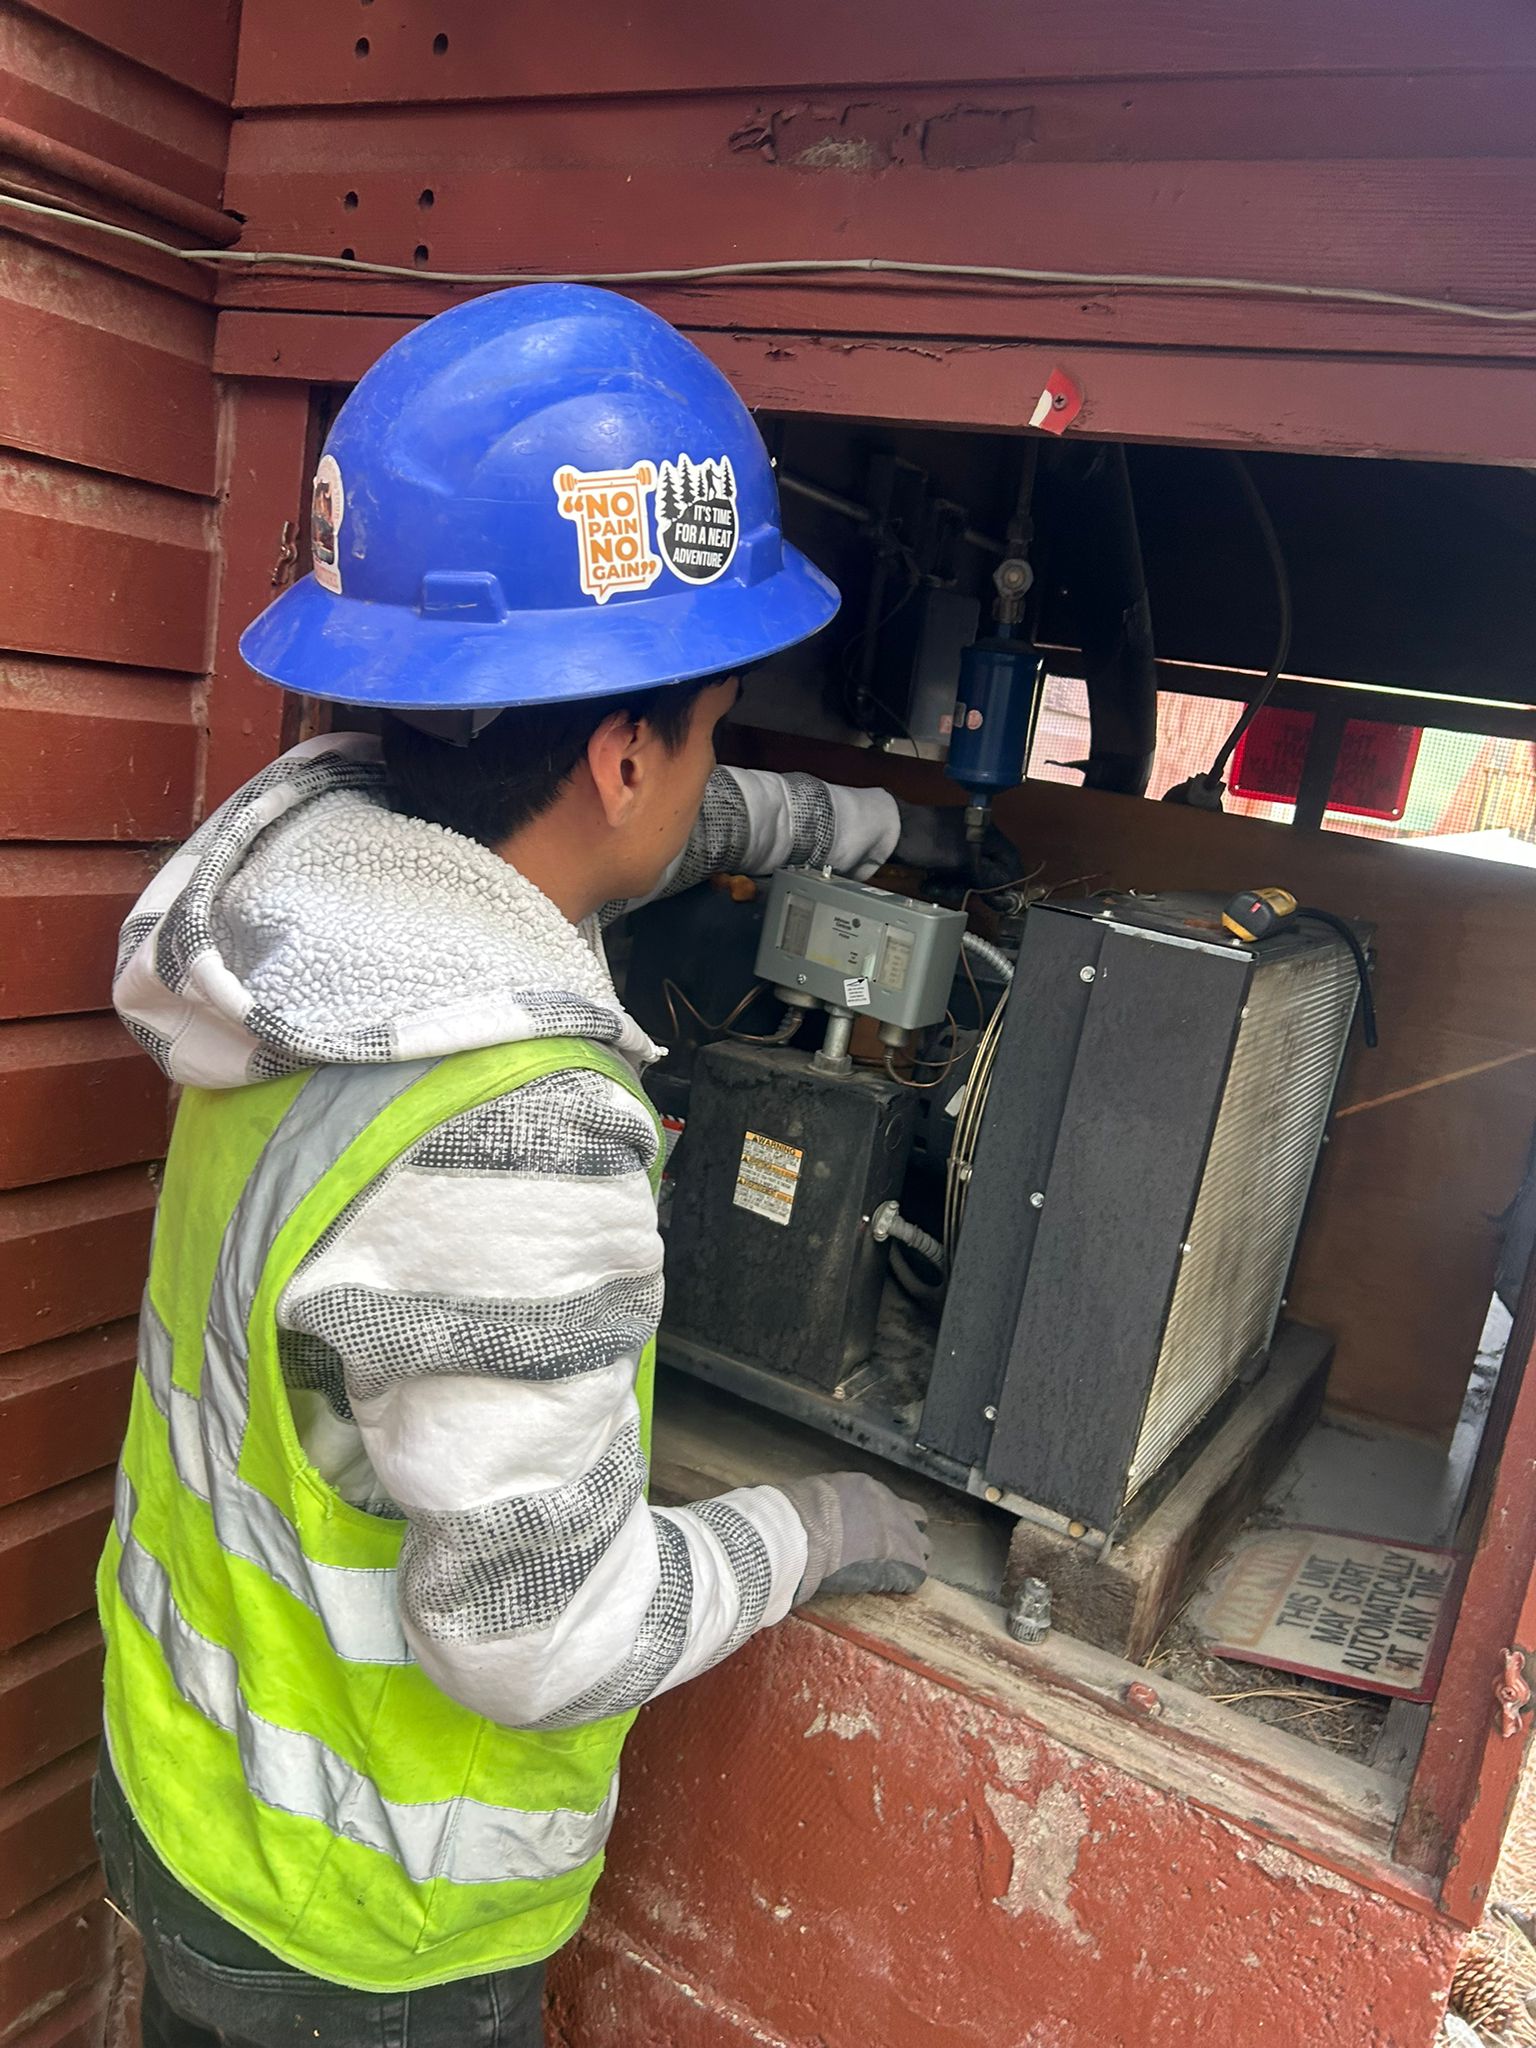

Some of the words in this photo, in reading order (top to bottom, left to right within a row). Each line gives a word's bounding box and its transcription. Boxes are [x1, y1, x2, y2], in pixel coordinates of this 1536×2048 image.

[588, 518, 638, 538] PAIN
[694, 504, 712, 522] IT'S
[713, 507, 732, 526] TIME
[590, 536, 639, 564] NO
[674, 524, 697, 543] FOR
[699, 527, 706, 544] A
[709, 527, 733, 548] NEAT
[672, 547, 724, 568] ADVENTURE
[759, 1135, 796, 1156] WARNING
[1276, 1592, 1321, 1629] THIS
[1299, 1554, 1342, 1589] UNIT
[1329, 1558, 1377, 1605] START
[1407, 1565, 1450, 1600] TIME
[1341, 1550, 1417, 1674] AUTOMATICALLY
[1395, 1604, 1438, 1641] ANY
[1310, 1609, 1356, 1646] MAY
[1386, 1644, 1424, 1671] AT
